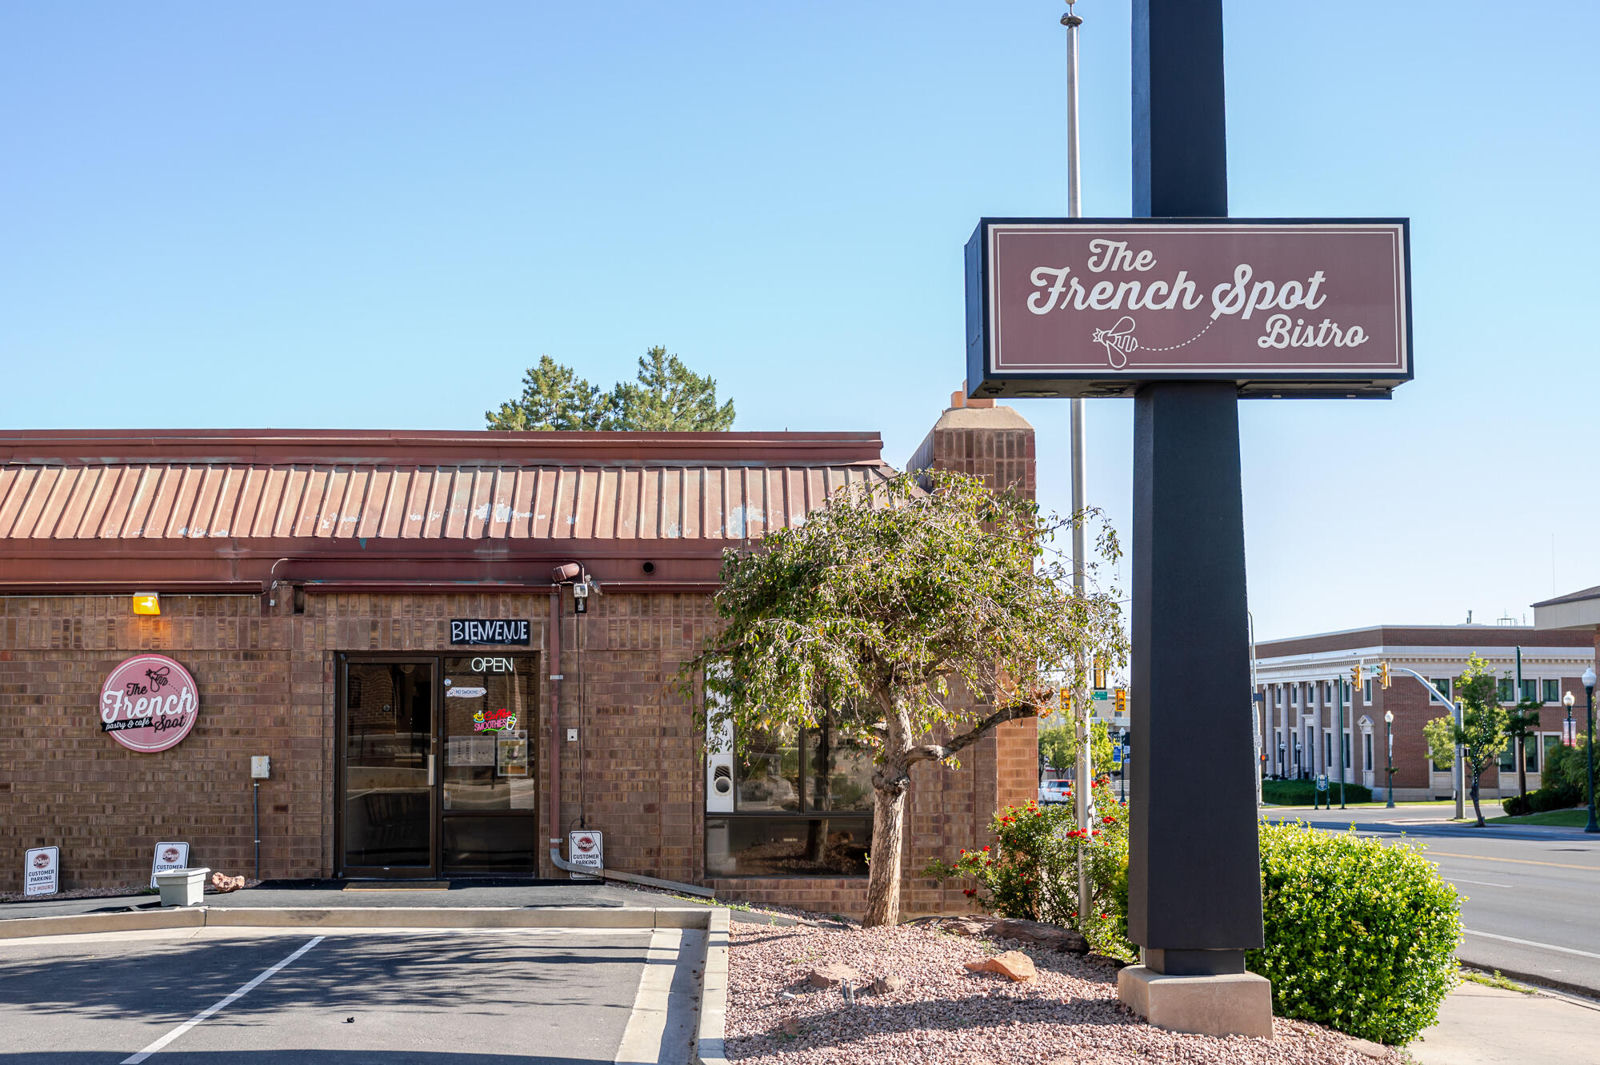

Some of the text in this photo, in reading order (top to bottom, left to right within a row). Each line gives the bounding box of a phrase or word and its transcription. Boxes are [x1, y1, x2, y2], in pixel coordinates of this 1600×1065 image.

[1087, 238, 1157, 273] The
[1026, 263, 1328, 320] French Spot
[1257, 313, 1369, 349] Bistro
[451, 620, 528, 641] BIENVENUE
[471, 657, 514, 672] OPEN
[126, 682, 148, 696] The
[102, 686, 197, 724] French
[484, 708, 513, 720] Coffee
[105, 721, 127, 731] pastry
[127, 720, 134, 729] &
[153, 714, 186, 733] Spot
[474, 718, 507, 732] SMOOTHIES
[28, 869, 54, 877] CUSTOMER
